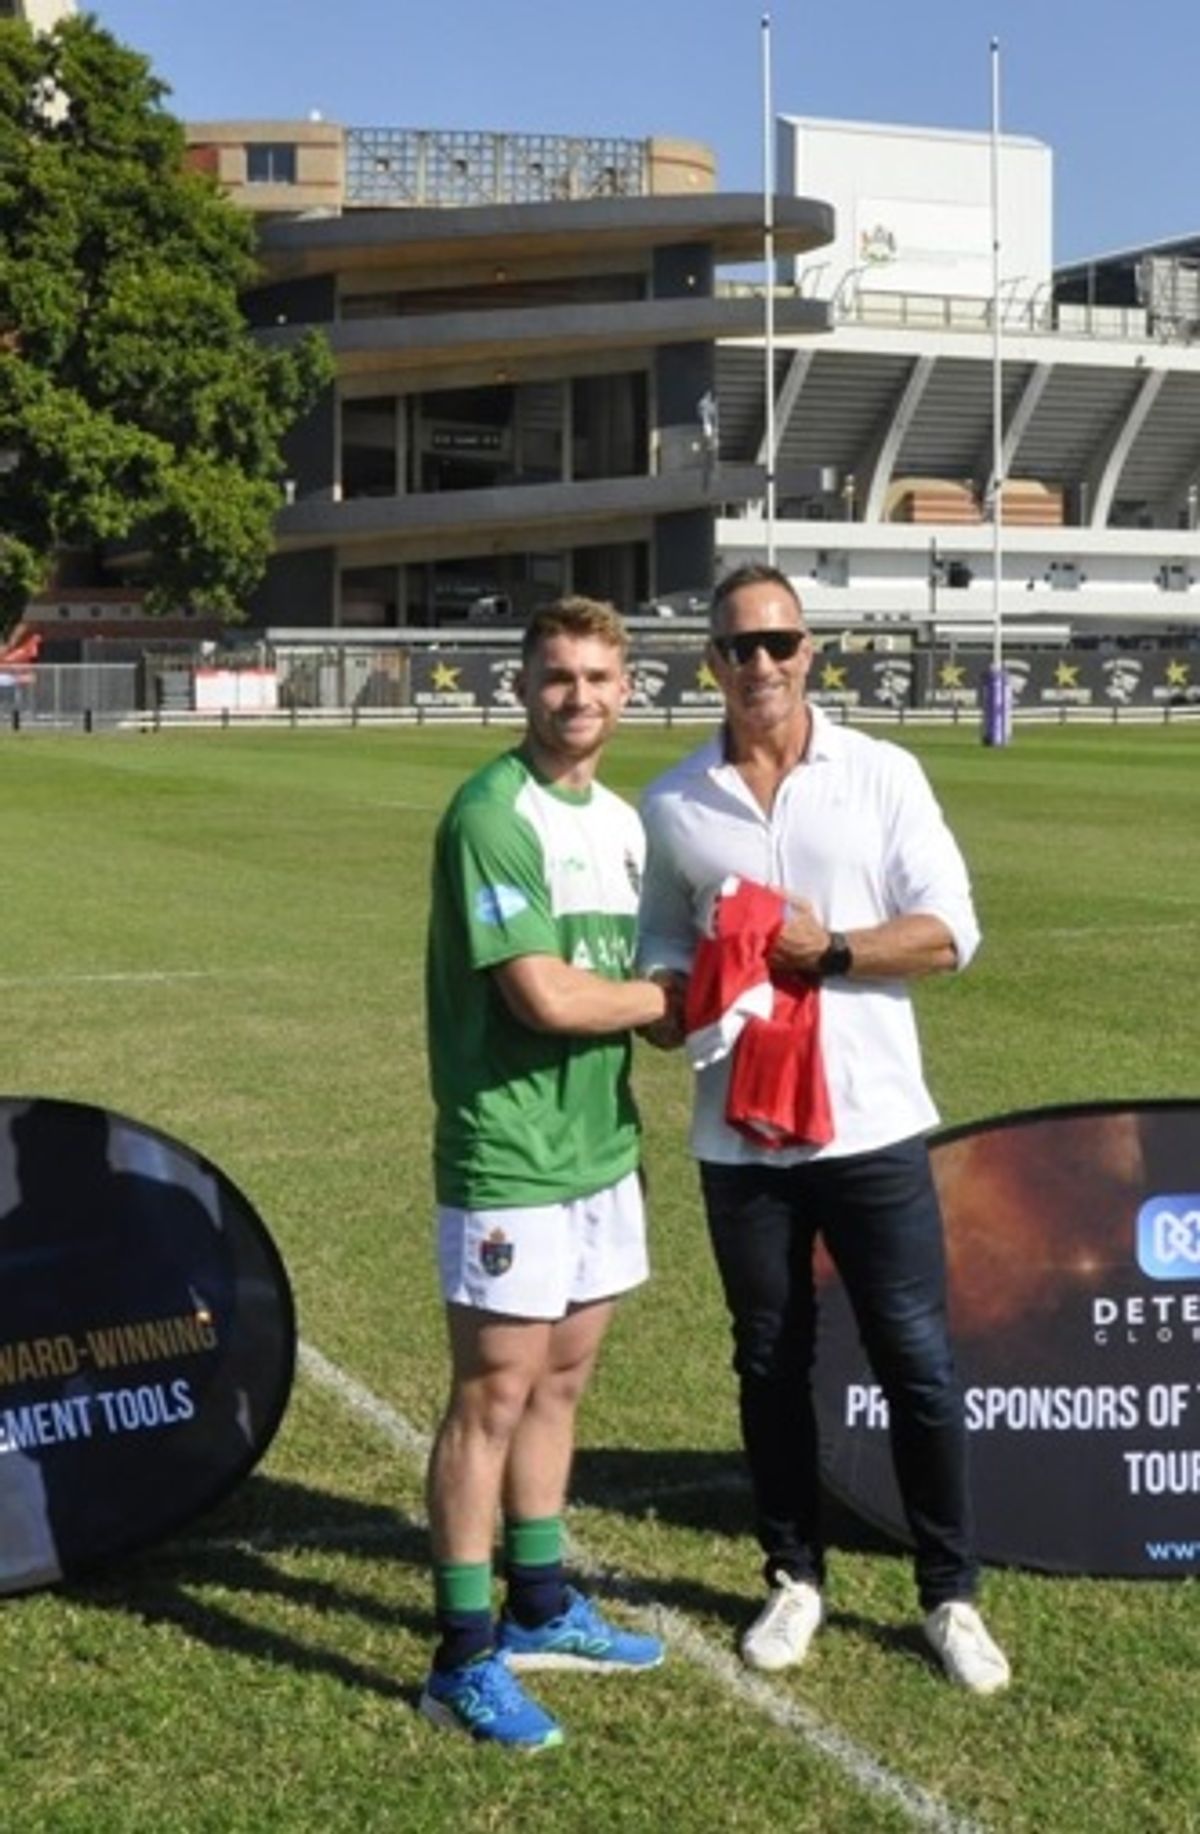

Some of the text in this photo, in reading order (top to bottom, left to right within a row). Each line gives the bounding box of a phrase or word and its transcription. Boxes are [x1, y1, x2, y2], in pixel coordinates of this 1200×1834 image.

[1094, 1295, 1200, 1325] DETE
[98, 1378, 195, 1433] TOOLS
[964, 1384, 1139, 1430] SPONSORS
[1148, 1383, 1190, 1428] OF
